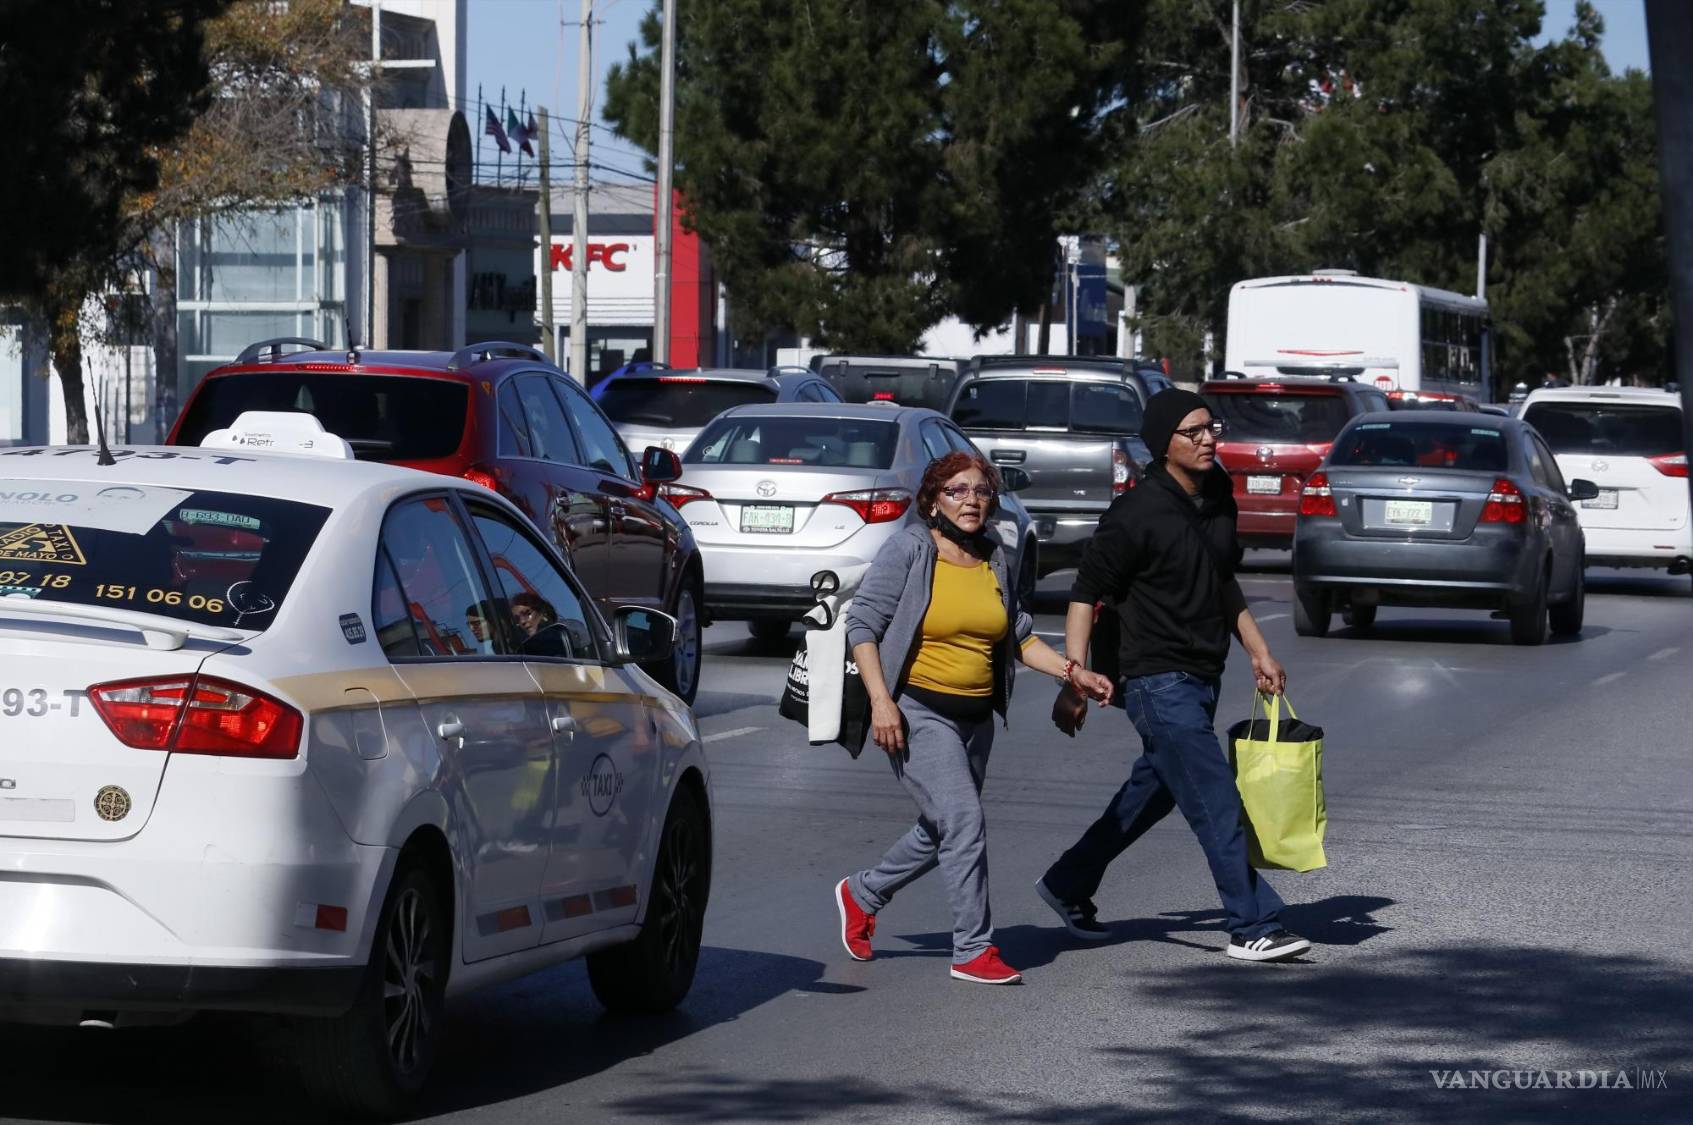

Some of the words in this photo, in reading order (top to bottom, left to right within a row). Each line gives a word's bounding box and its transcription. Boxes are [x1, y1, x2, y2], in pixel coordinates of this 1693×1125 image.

[551, 243, 629, 272] KFC
[0, 527, 41, 546] ADIO
[48, 529, 72, 552] TAXI
[16, 551, 57, 560] MAYO
[40, 574, 72, 588] 18
[95, 584, 137, 600] 151
[147, 588, 182, 605] 06
[188, 595, 224, 613] 06
[2, 688, 88, 717] 93-T
[593, 774, 613, 797] TAXI
